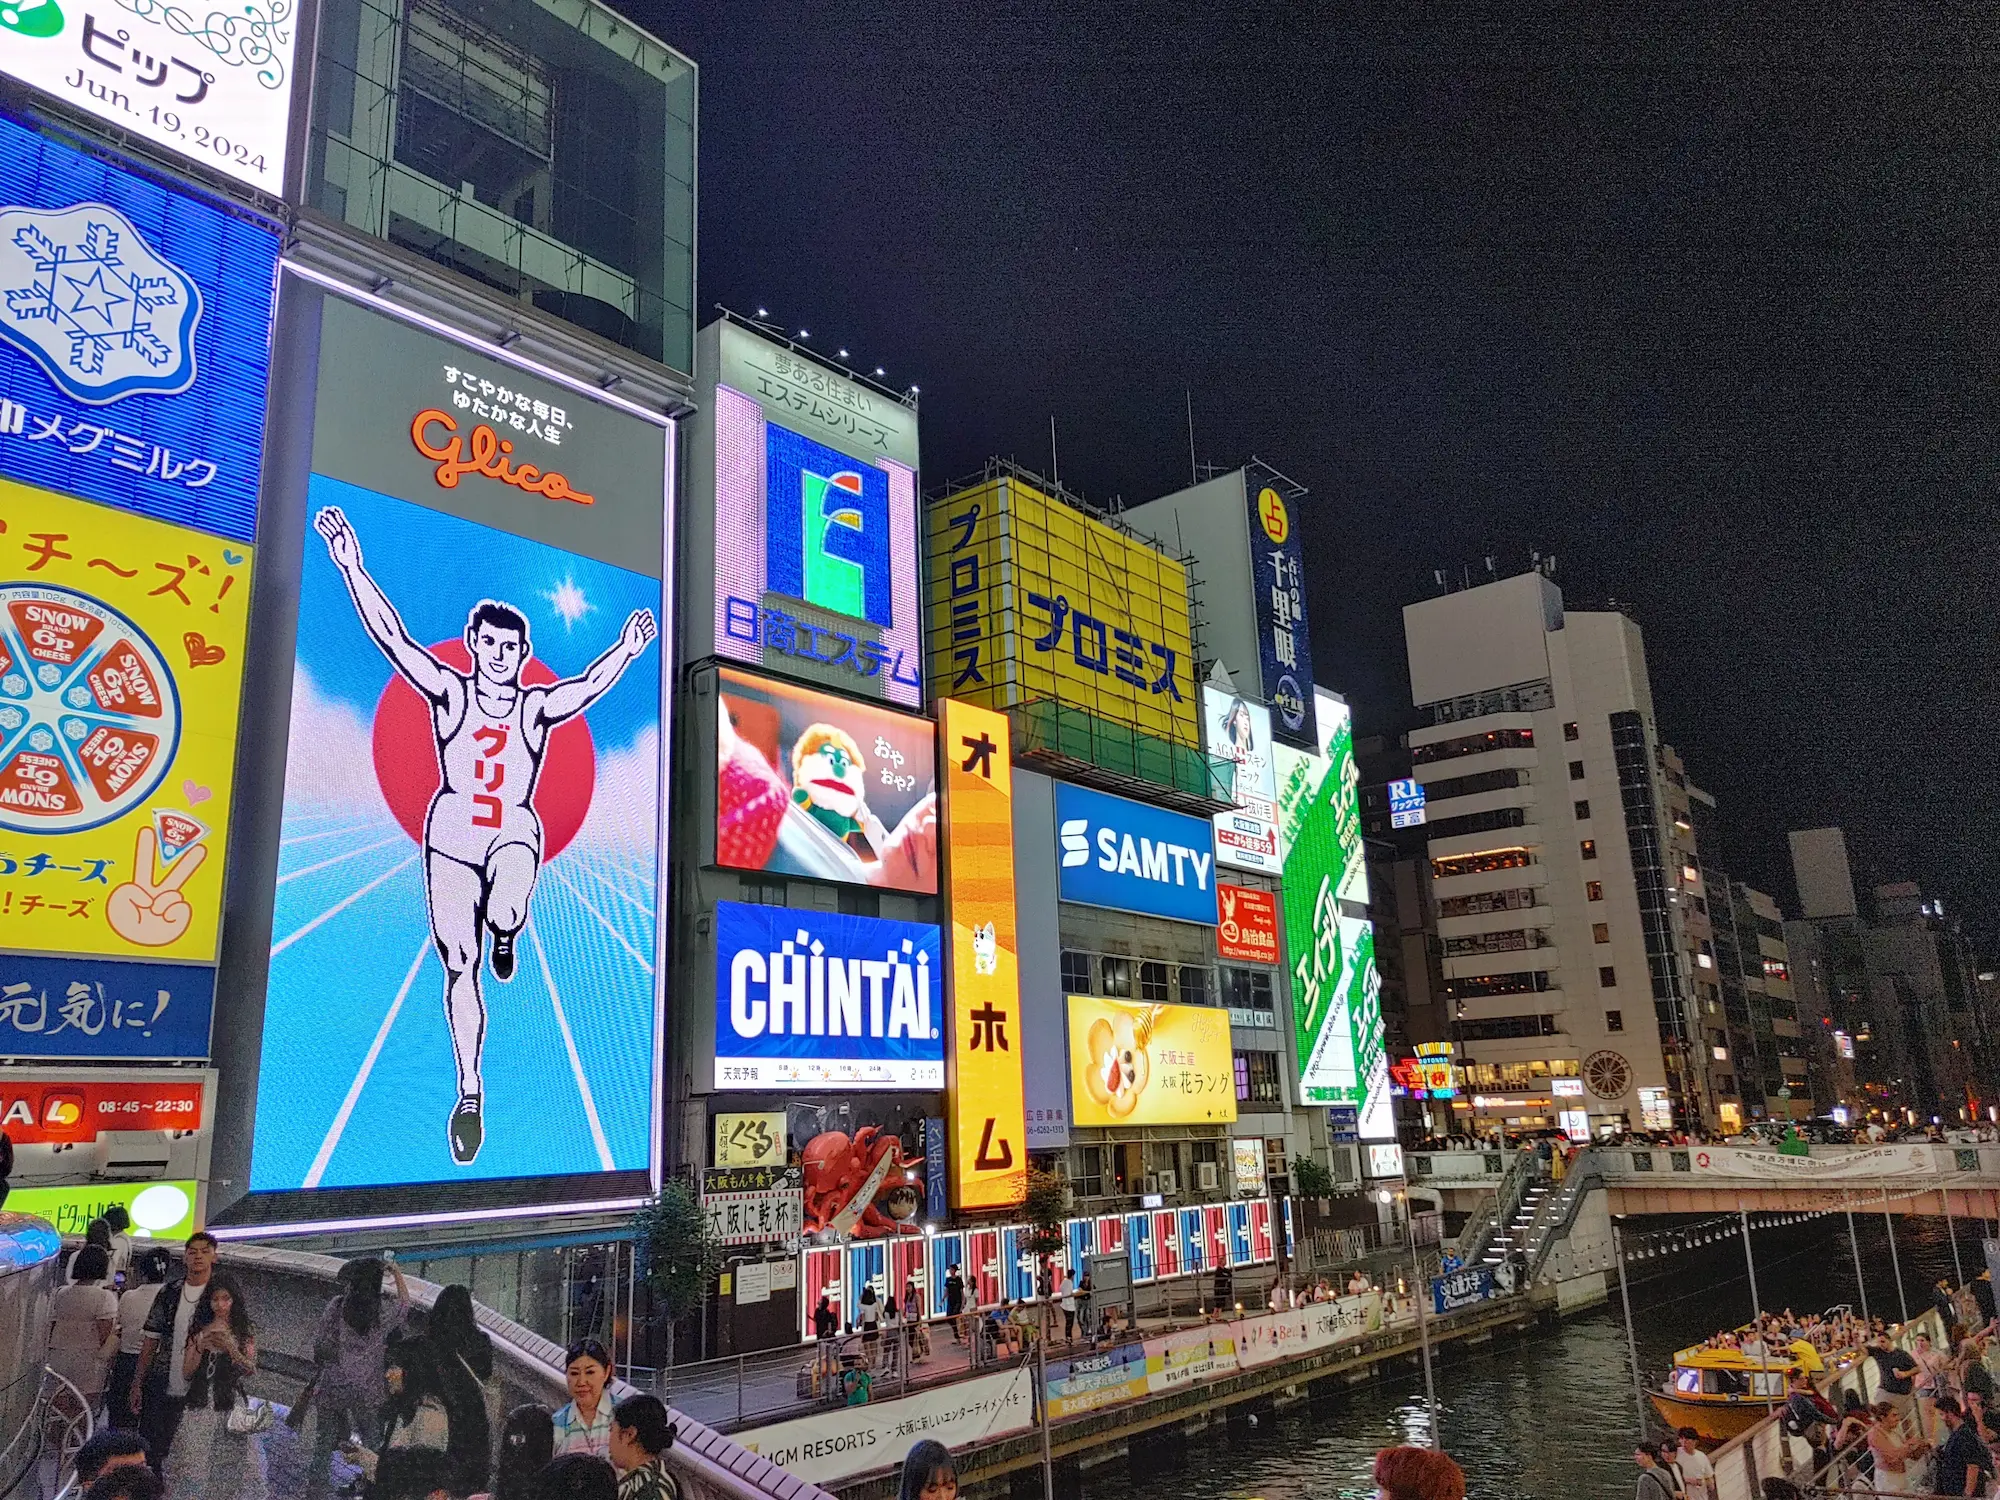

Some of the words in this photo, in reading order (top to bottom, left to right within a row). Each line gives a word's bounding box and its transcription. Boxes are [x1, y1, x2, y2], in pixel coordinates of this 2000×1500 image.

[82, 13, 215, 104] ピップ
[65, 68, 140, 116] Jun.
[149, 105, 187, 140] 19,
[194, 126, 268, 173] 2024
[443, 365, 573, 429] すこやかな毎日、
[774, 353, 872, 411] 夢ある住まい
[453, 390, 561, 445] ゆたかな人生
[757, 376, 888, 450] エステムシリーズ
[1265, 491, 1283, 537] 占
[950, 504, 987, 690] プロミス
[25, 606, 90, 631] SNOW
[42, 624, 71, 634] BRAND
[32, 629, 75, 652] 6P
[32, 648, 72, 662] CHEESE
[727, 596, 921, 687] 日商エステム
[1028, 592, 1183, 703] プロミス
[89, 674, 111, 707] CHEESE
[103, 668, 126, 704] 6P
[119, 653, 157, 706] SNOW
[19, 754, 59, 767] CHEESE
[80, 728, 108, 758] CHEESE
[92, 737, 124, 767] 6P
[874, 736, 904, 769] おや
[15, 764, 59, 787] 6P
[105, 742, 150, 793] SNOW
[472, 724, 510, 828] グリコ
[0, 788, 66, 810] SNOW
[165, 818, 195, 833] SNOW
[1097, 827, 1211, 890] SAMTY
[1296, 893, 1343, 1008] エイブル
[730, 929, 930, 1039] CHINTAI
[1352, 963, 1382, 1041] エイブル
[723, 1067, 759, 1080] 天気予報
[1159, 1051, 1195, 1066] 大阪土産
[1161, 1076, 1176, 1089] 大阪
[1179, 1071, 1230, 1095] 花ラング
[729, 1120, 772, 1159] くくる
[708, 1199, 789, 1237] 大阪に乾杯
[804, 1430, 876, 1461] RESORTS
